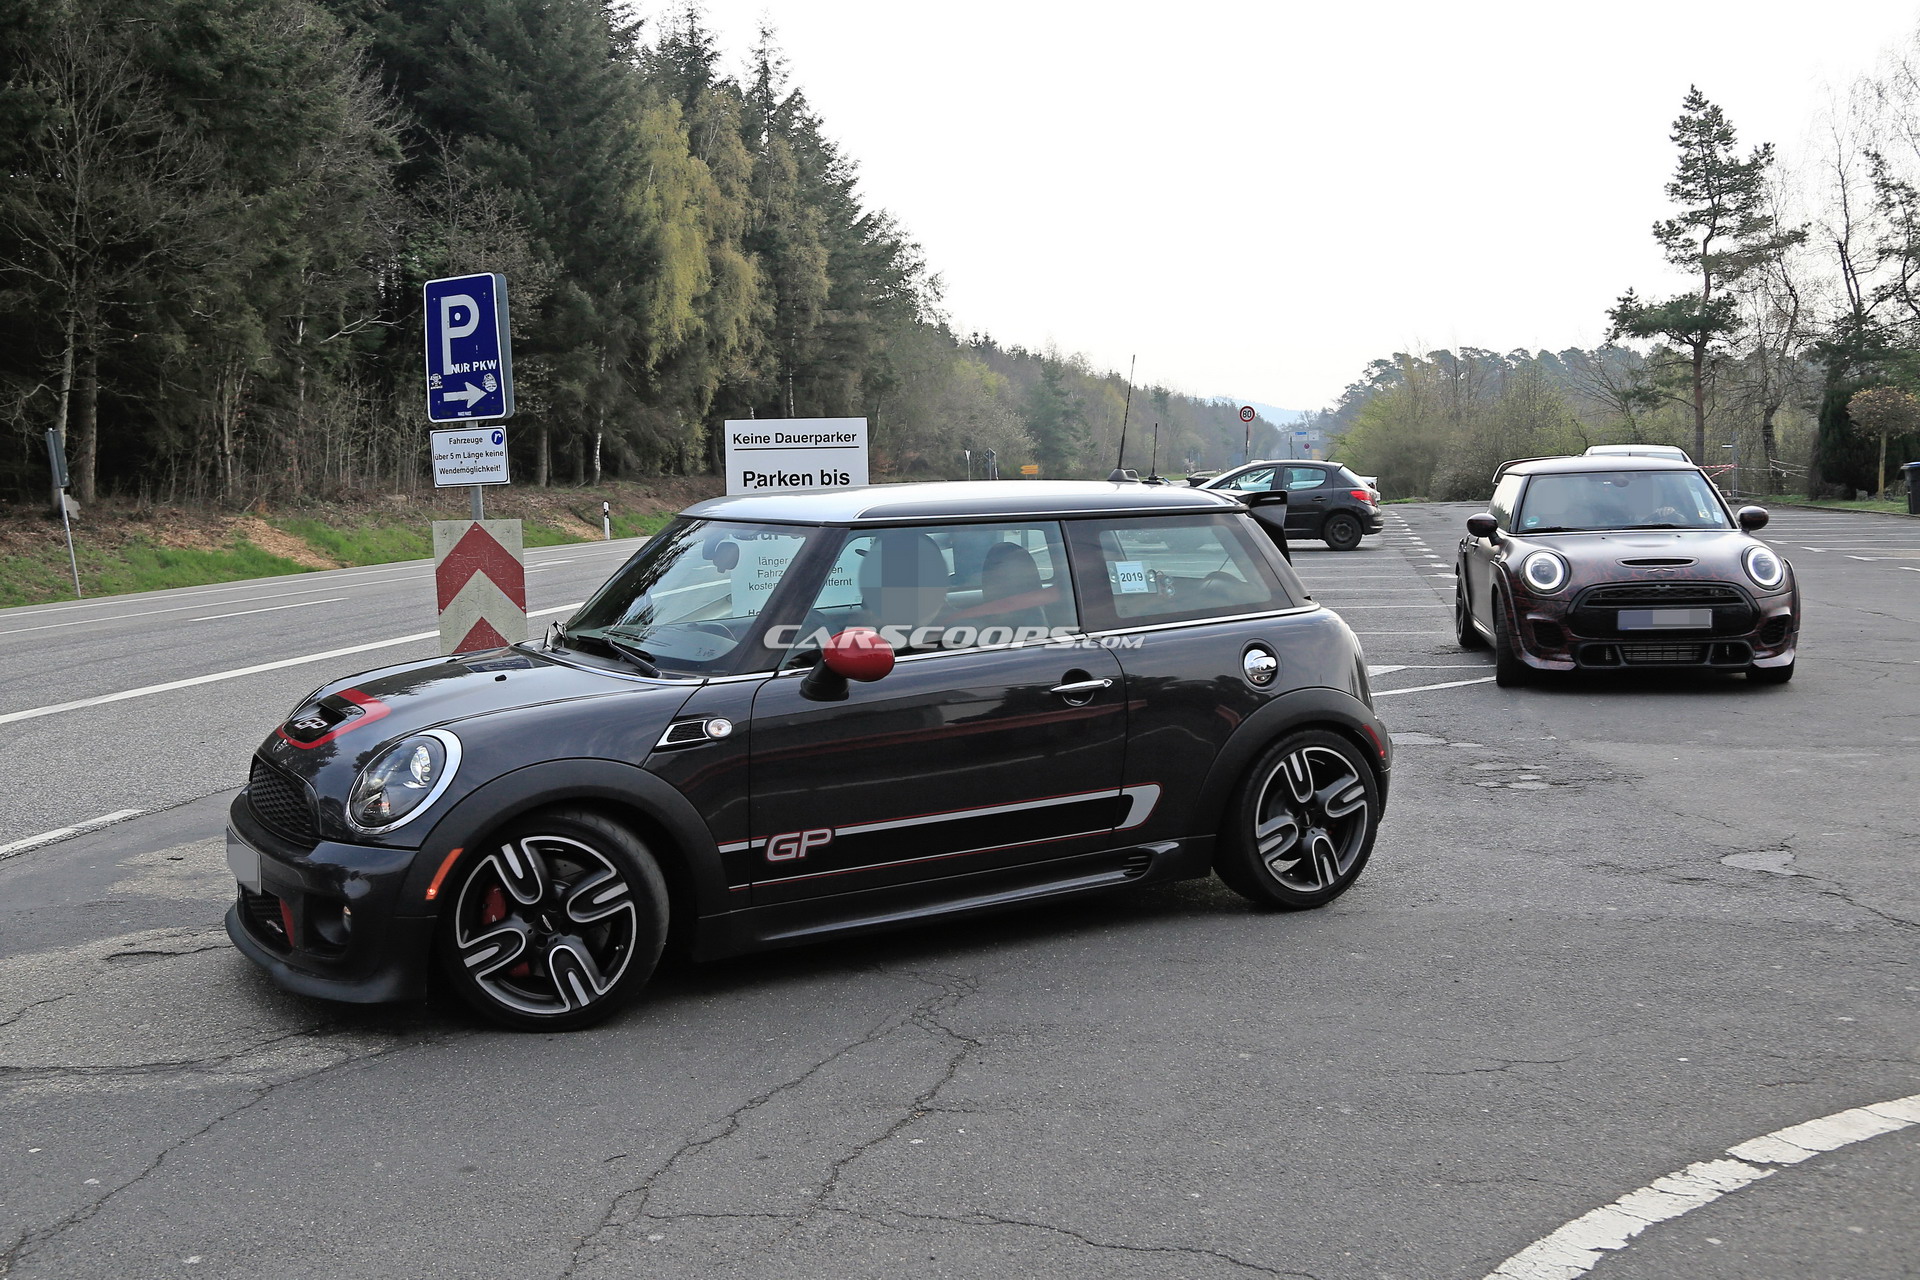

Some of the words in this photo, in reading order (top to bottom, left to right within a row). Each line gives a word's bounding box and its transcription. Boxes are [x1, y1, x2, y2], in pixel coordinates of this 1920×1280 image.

[441, 294, 480, 376] P
[451, 362, 471, 374] NUR
[472, 360, 497, 372] PKW
[1242, 410, 1252, 418] 80
[448, 437, 483, 445] Fahrzeuge
[733, 432, 771, 445] Keine
[774, 431, 857, 446] Dauerparker
[434, 453, 449, 461] über
[450, 452, 455, 460] 5
[463, 451, 484, 460] Länge
[485, 450, 504, 458] keine
[439, 465, 501, 475] Wendemöglichkeit!
[743, 469, 813, 488] Parken
[820, 469, 851, 486] bis
[758, 556, 788, 568] länger
[757, 569, 784, 579] Fahrz
[831, 566, 843, 574] en
[1120, 572, 1144, 582] 2019
[826, 577, 853, 587] tfernt
[294, 717, 328, 730] GP
[767, 828, 832, 861] GP
